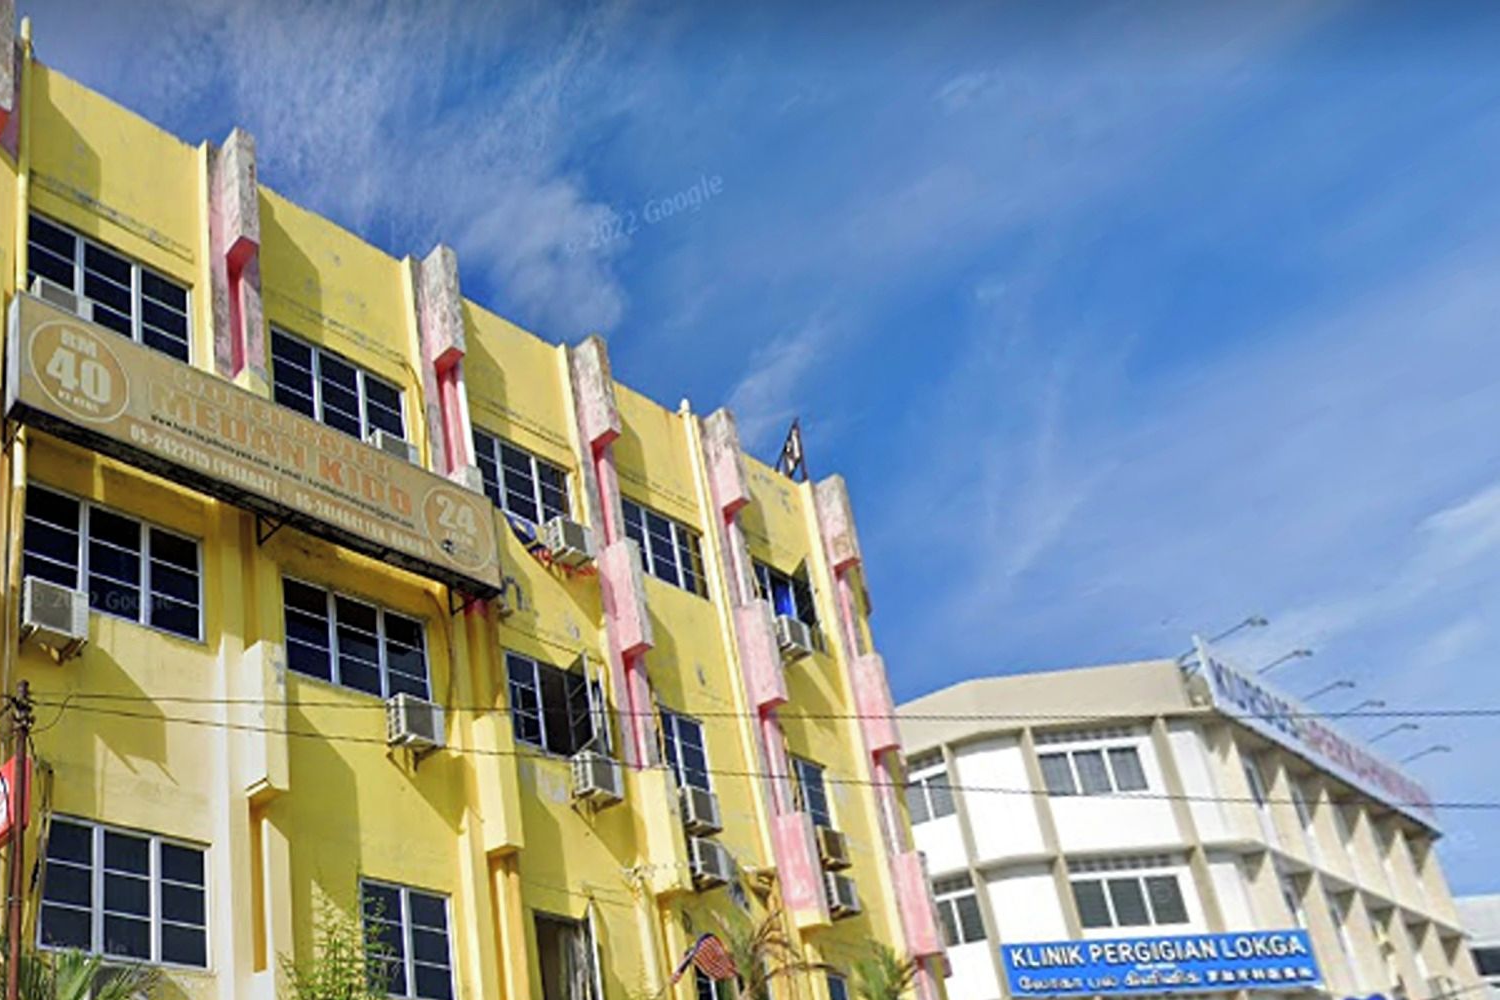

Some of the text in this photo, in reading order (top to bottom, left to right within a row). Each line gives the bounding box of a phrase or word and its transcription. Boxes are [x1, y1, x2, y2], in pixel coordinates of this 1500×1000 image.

[46, 346, 112, 405] 40
[434, 494, 479, 536] 24
[1011, 945, 1085, 968] KLINIK
[1088, 938, 1219, 965] PERGIGIAN
